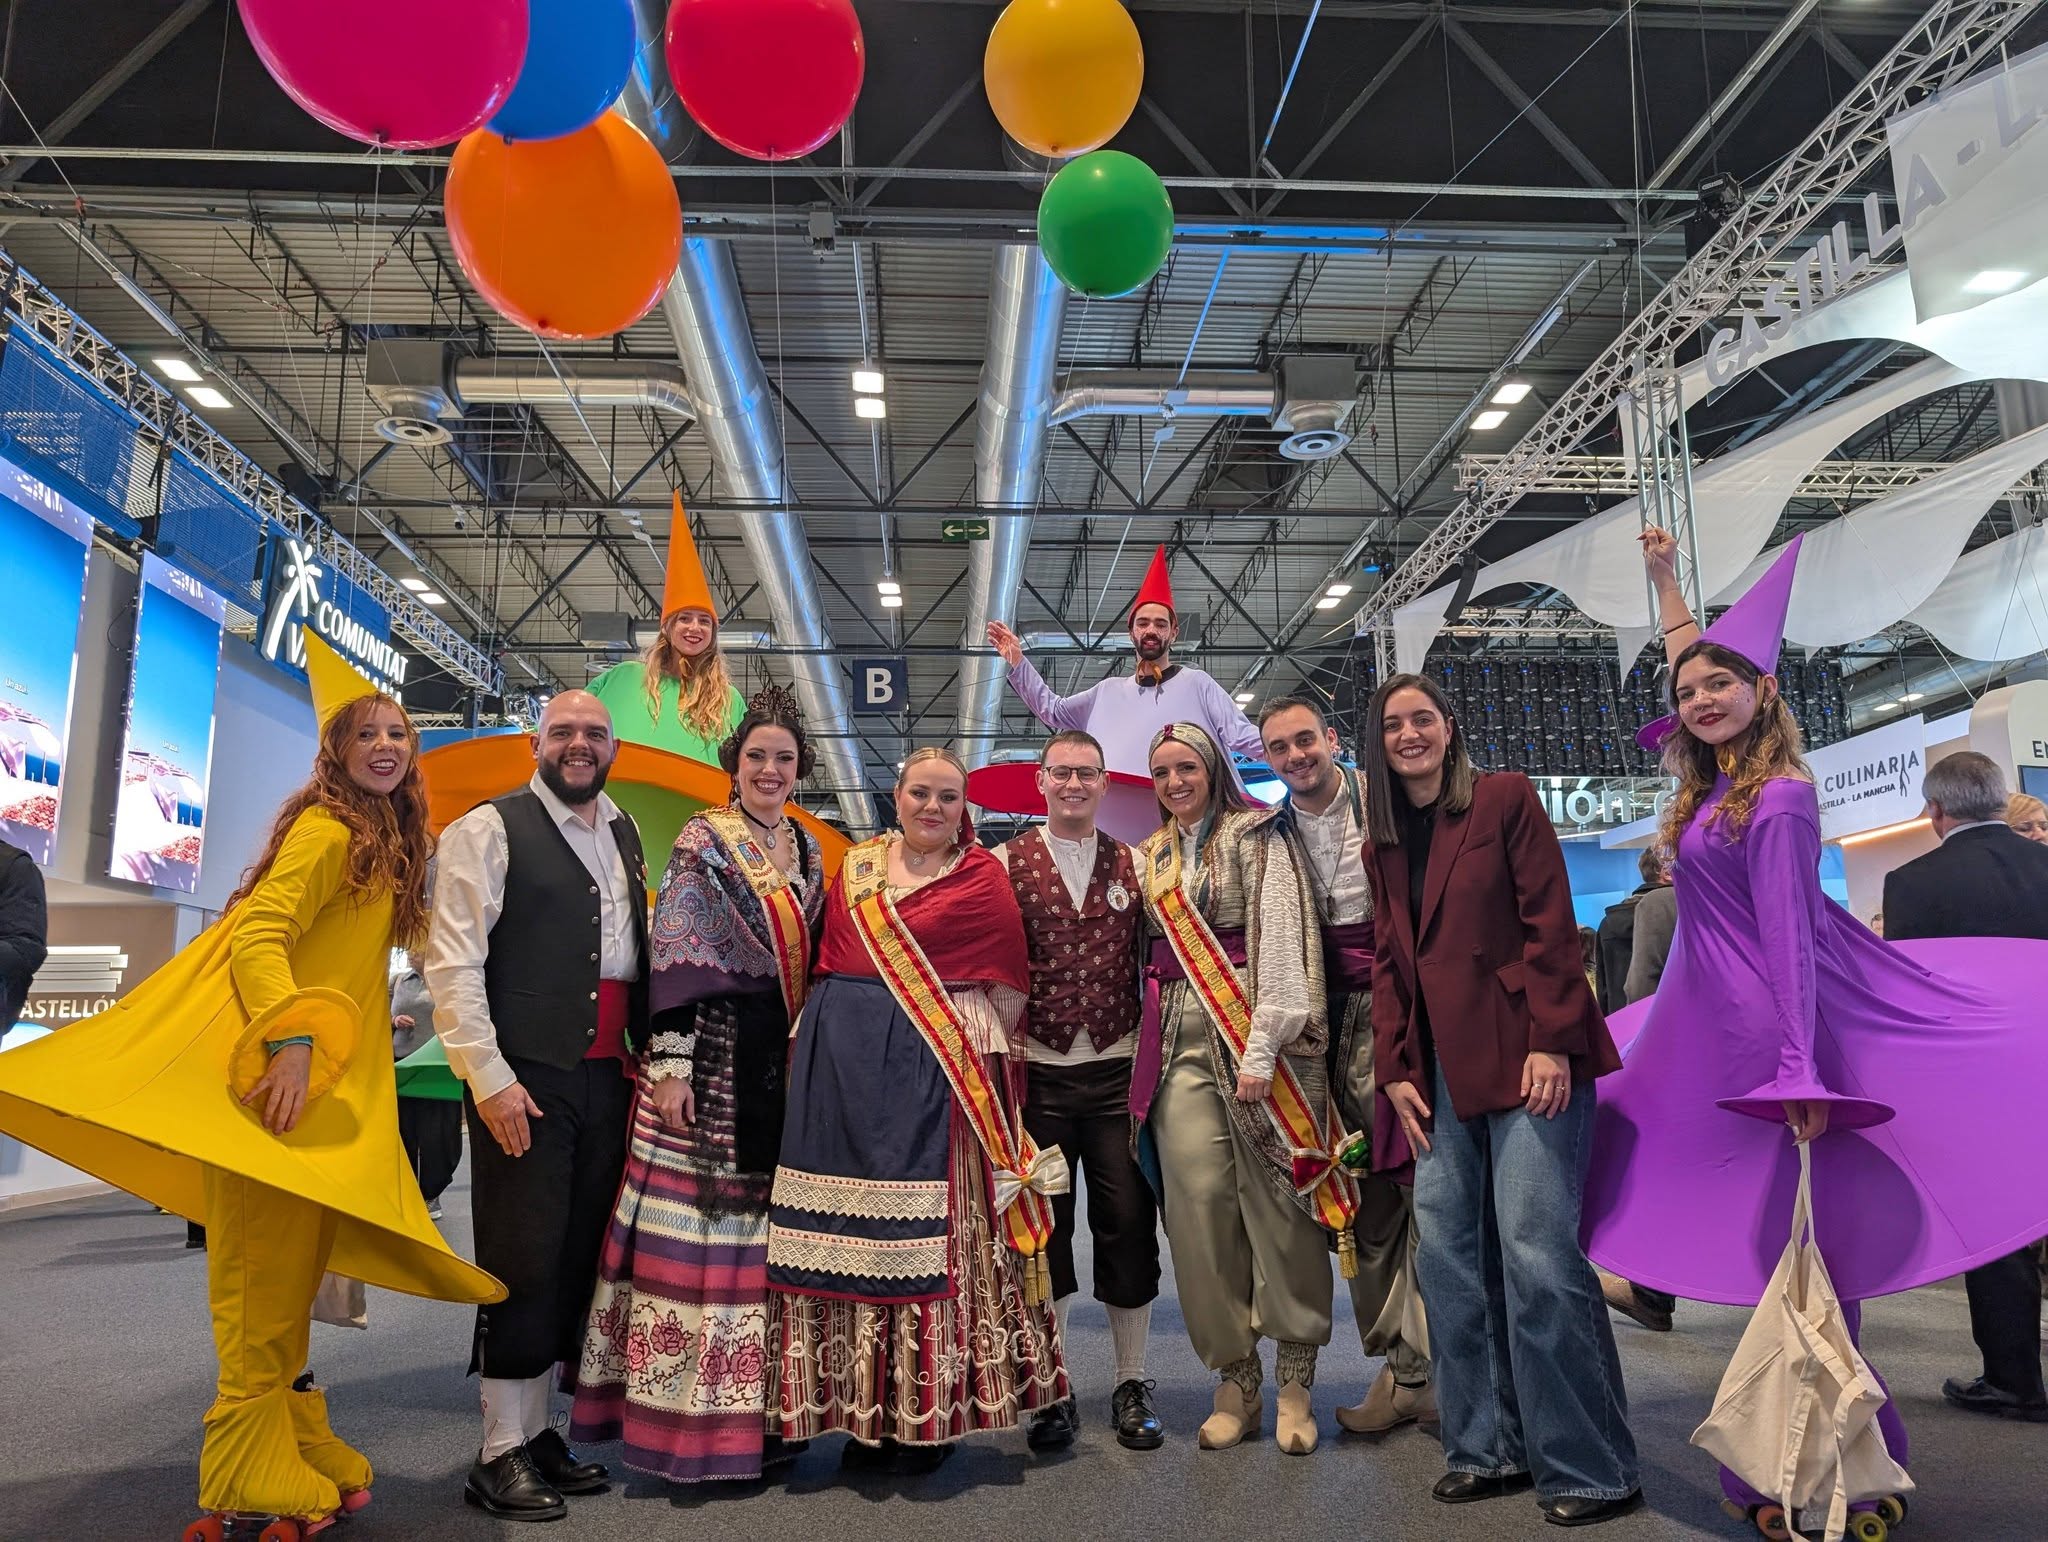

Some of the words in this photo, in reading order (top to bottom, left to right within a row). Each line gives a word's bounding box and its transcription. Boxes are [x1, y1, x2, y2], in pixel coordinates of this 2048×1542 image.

[1704, 153, 1947, 387] CASTILLA
[316, 600, 409, 685] COMUNITAT
[866, 667, 893, 704] B
[1824, 750, 1919, 797] CULINARIA
[1852, 793, 1862, 802] LA
[1863, 783, 1896, 798] MANCHA
[1537, 777, 1632, 823] ión
[19, 995, 122, 1019] ASTELLÓ
